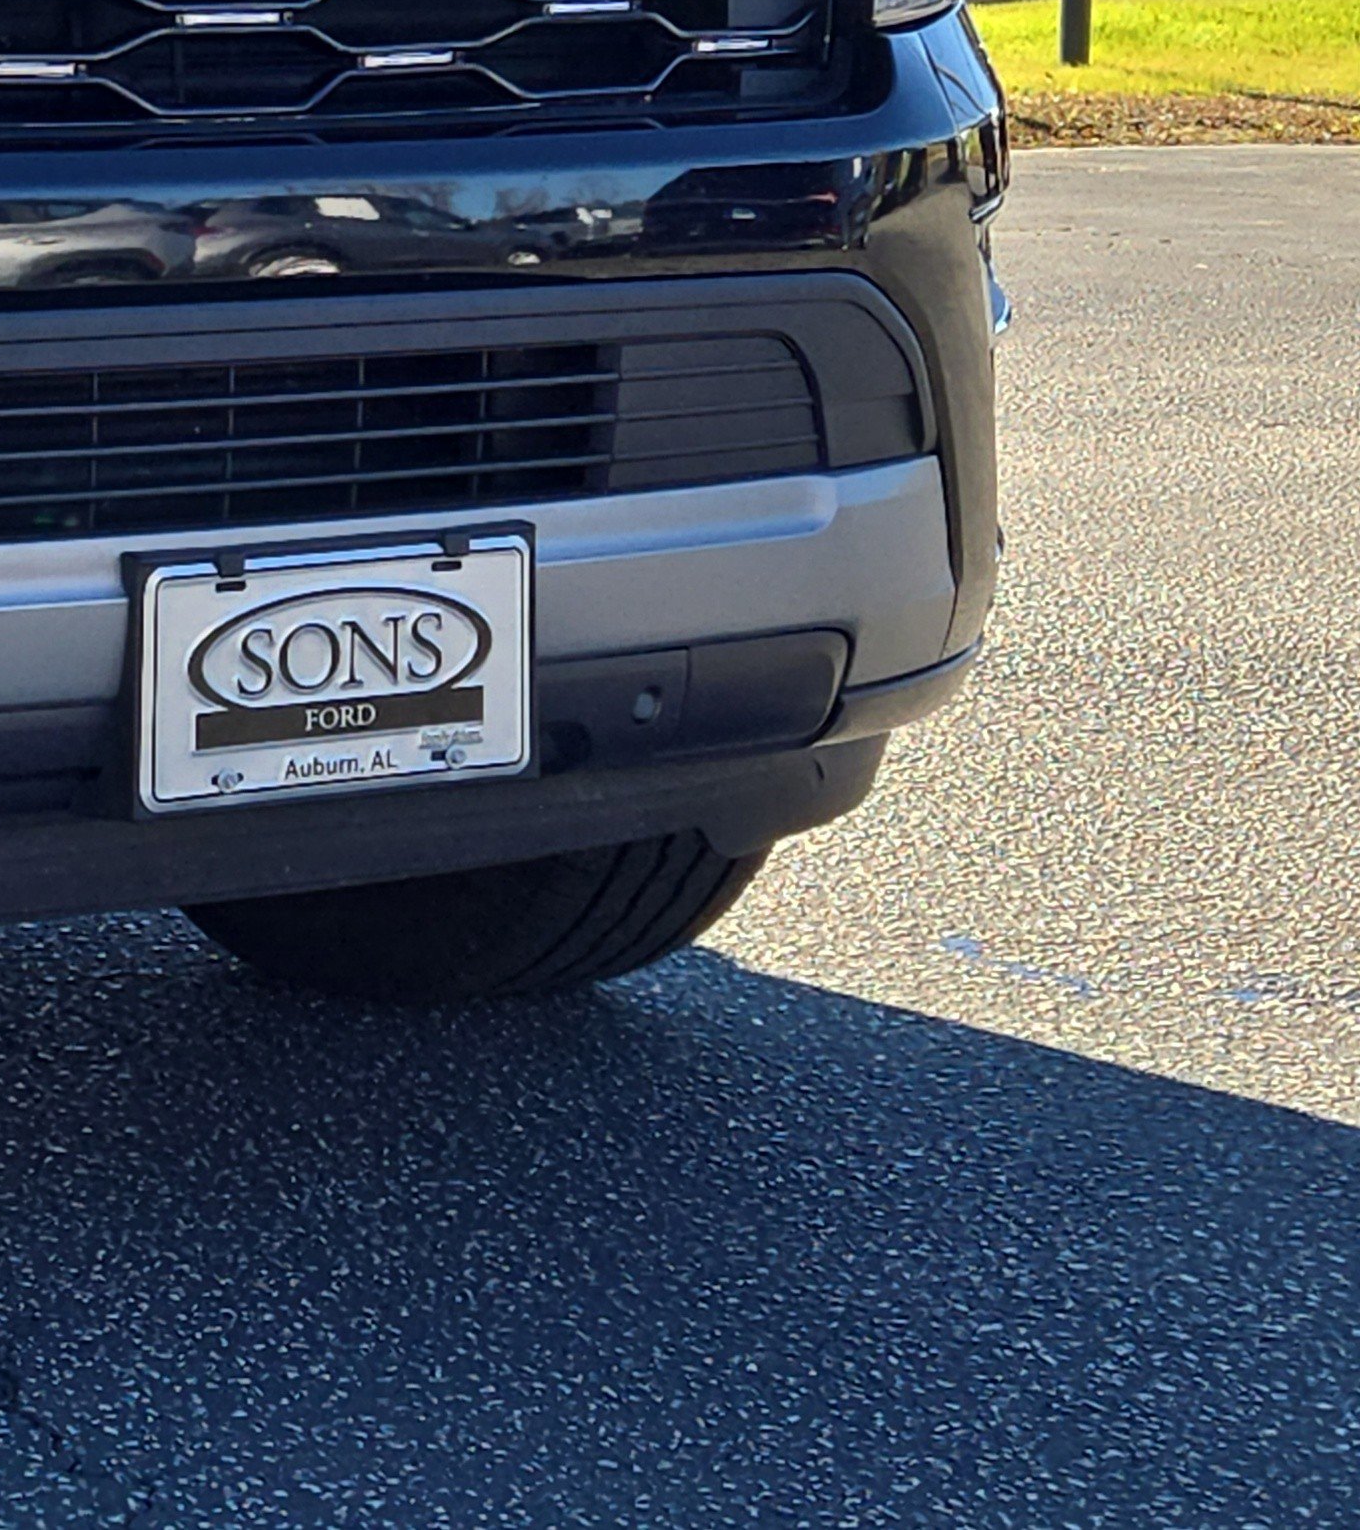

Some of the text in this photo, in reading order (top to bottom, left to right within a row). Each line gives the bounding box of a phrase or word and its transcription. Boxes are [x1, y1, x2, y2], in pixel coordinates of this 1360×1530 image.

[235, 611, 444, 697] SONS
[304, 703, 377, 732] FORD
[284, 748, 399, 780] Auburn, AL
